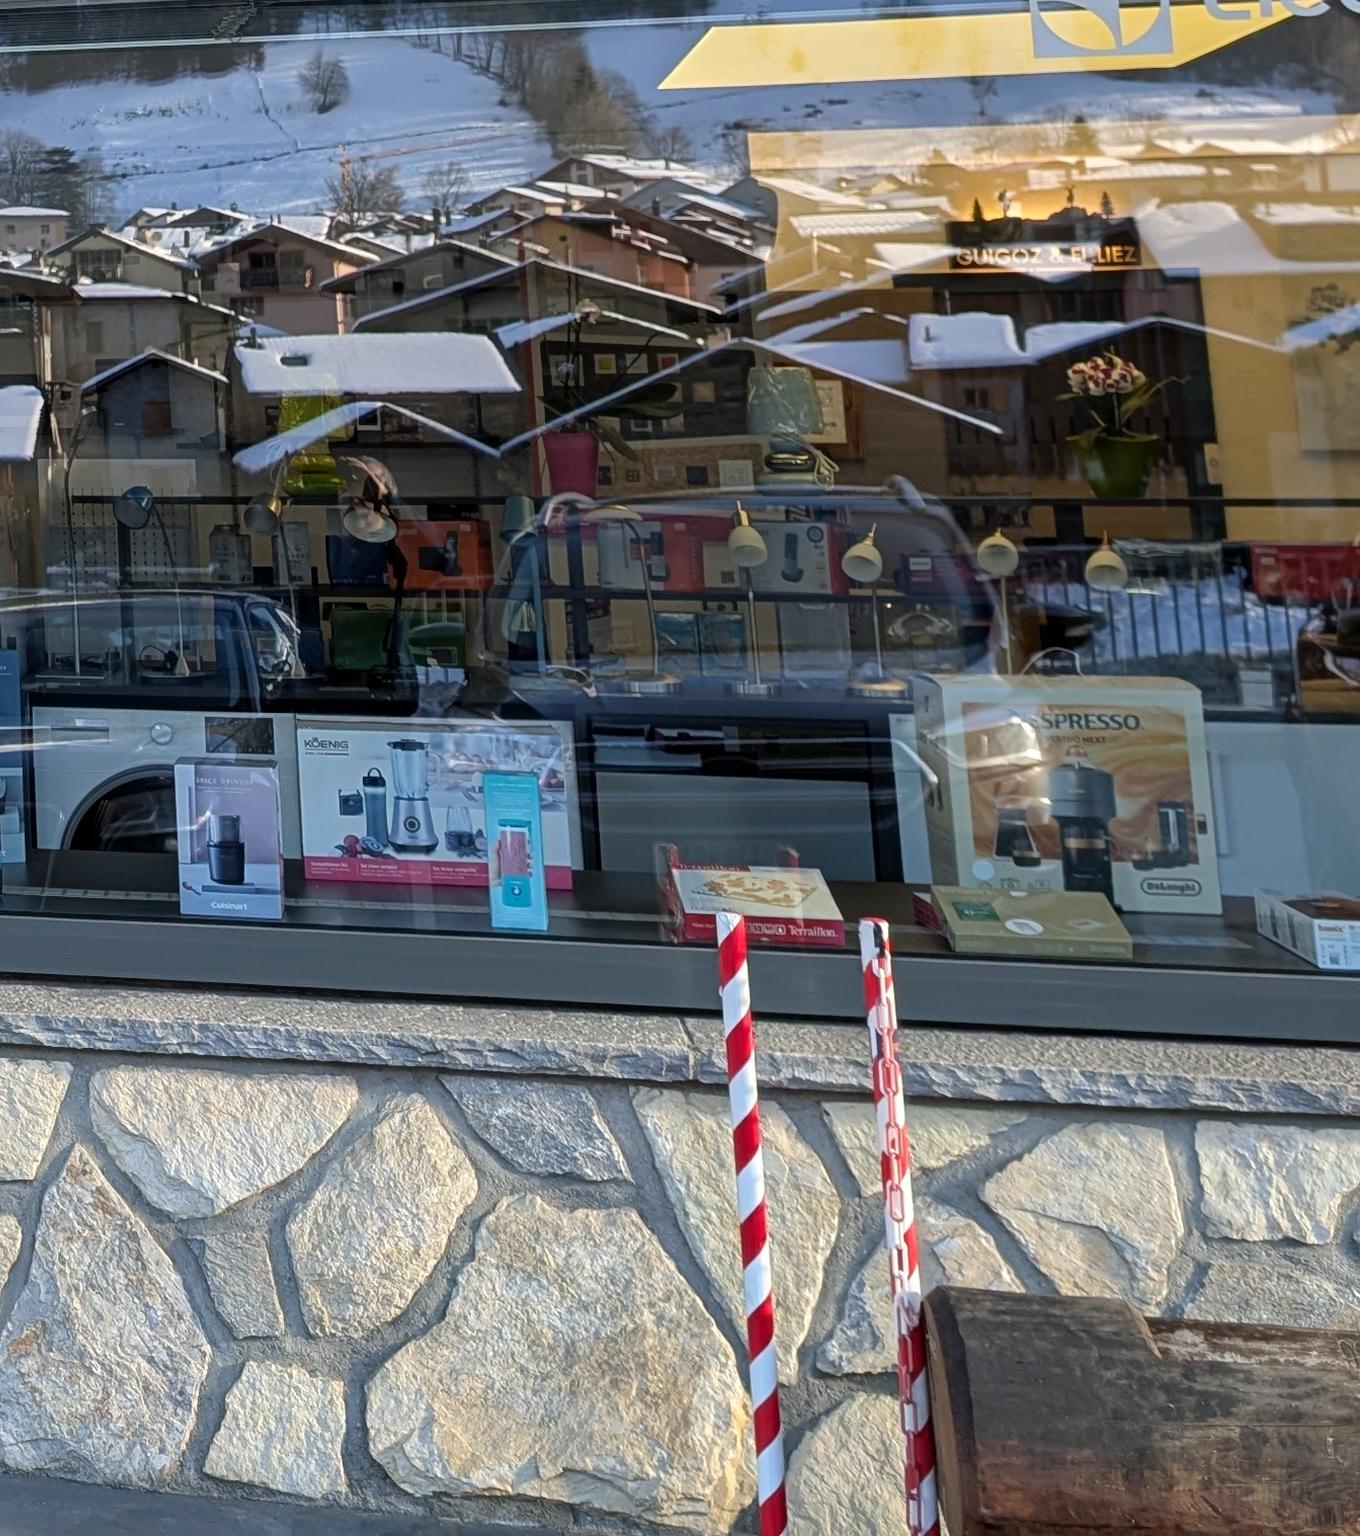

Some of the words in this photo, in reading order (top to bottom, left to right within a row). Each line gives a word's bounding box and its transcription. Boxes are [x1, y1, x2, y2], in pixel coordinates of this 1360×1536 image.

[956, 247, 1044, 266] GUIGOZ
[1008, 709, 1141, 731] SPRESSO
[211, 901, 248, 911] Cuisinart
